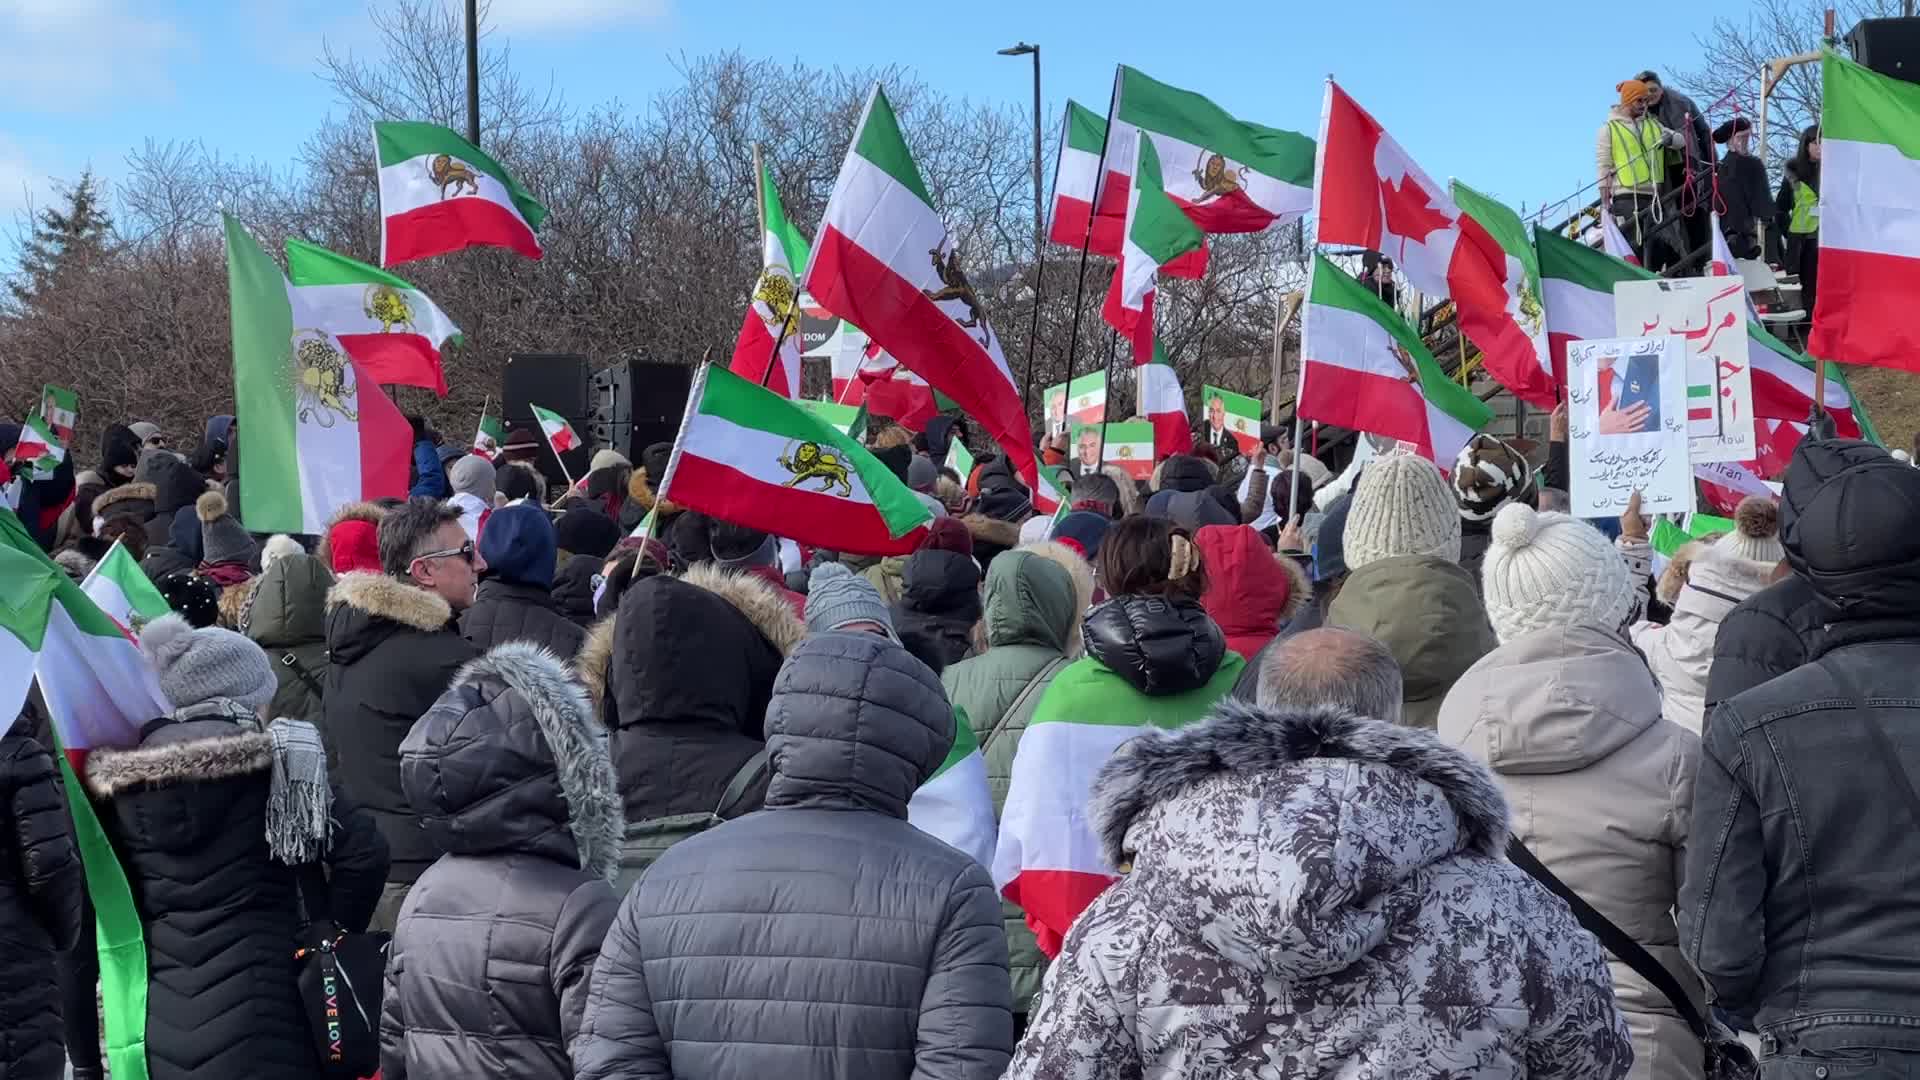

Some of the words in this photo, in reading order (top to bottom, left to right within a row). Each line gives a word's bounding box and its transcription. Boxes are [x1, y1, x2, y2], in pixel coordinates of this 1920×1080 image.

[1670, 284, 1744, 354] مرگ
[1635, 340, 1665, 354] ایران
[1715, 462, 1742, 480] Iran
[323, 976, 338, 1017] LOVE
[327, 1021, 342, 1061] LOVE
